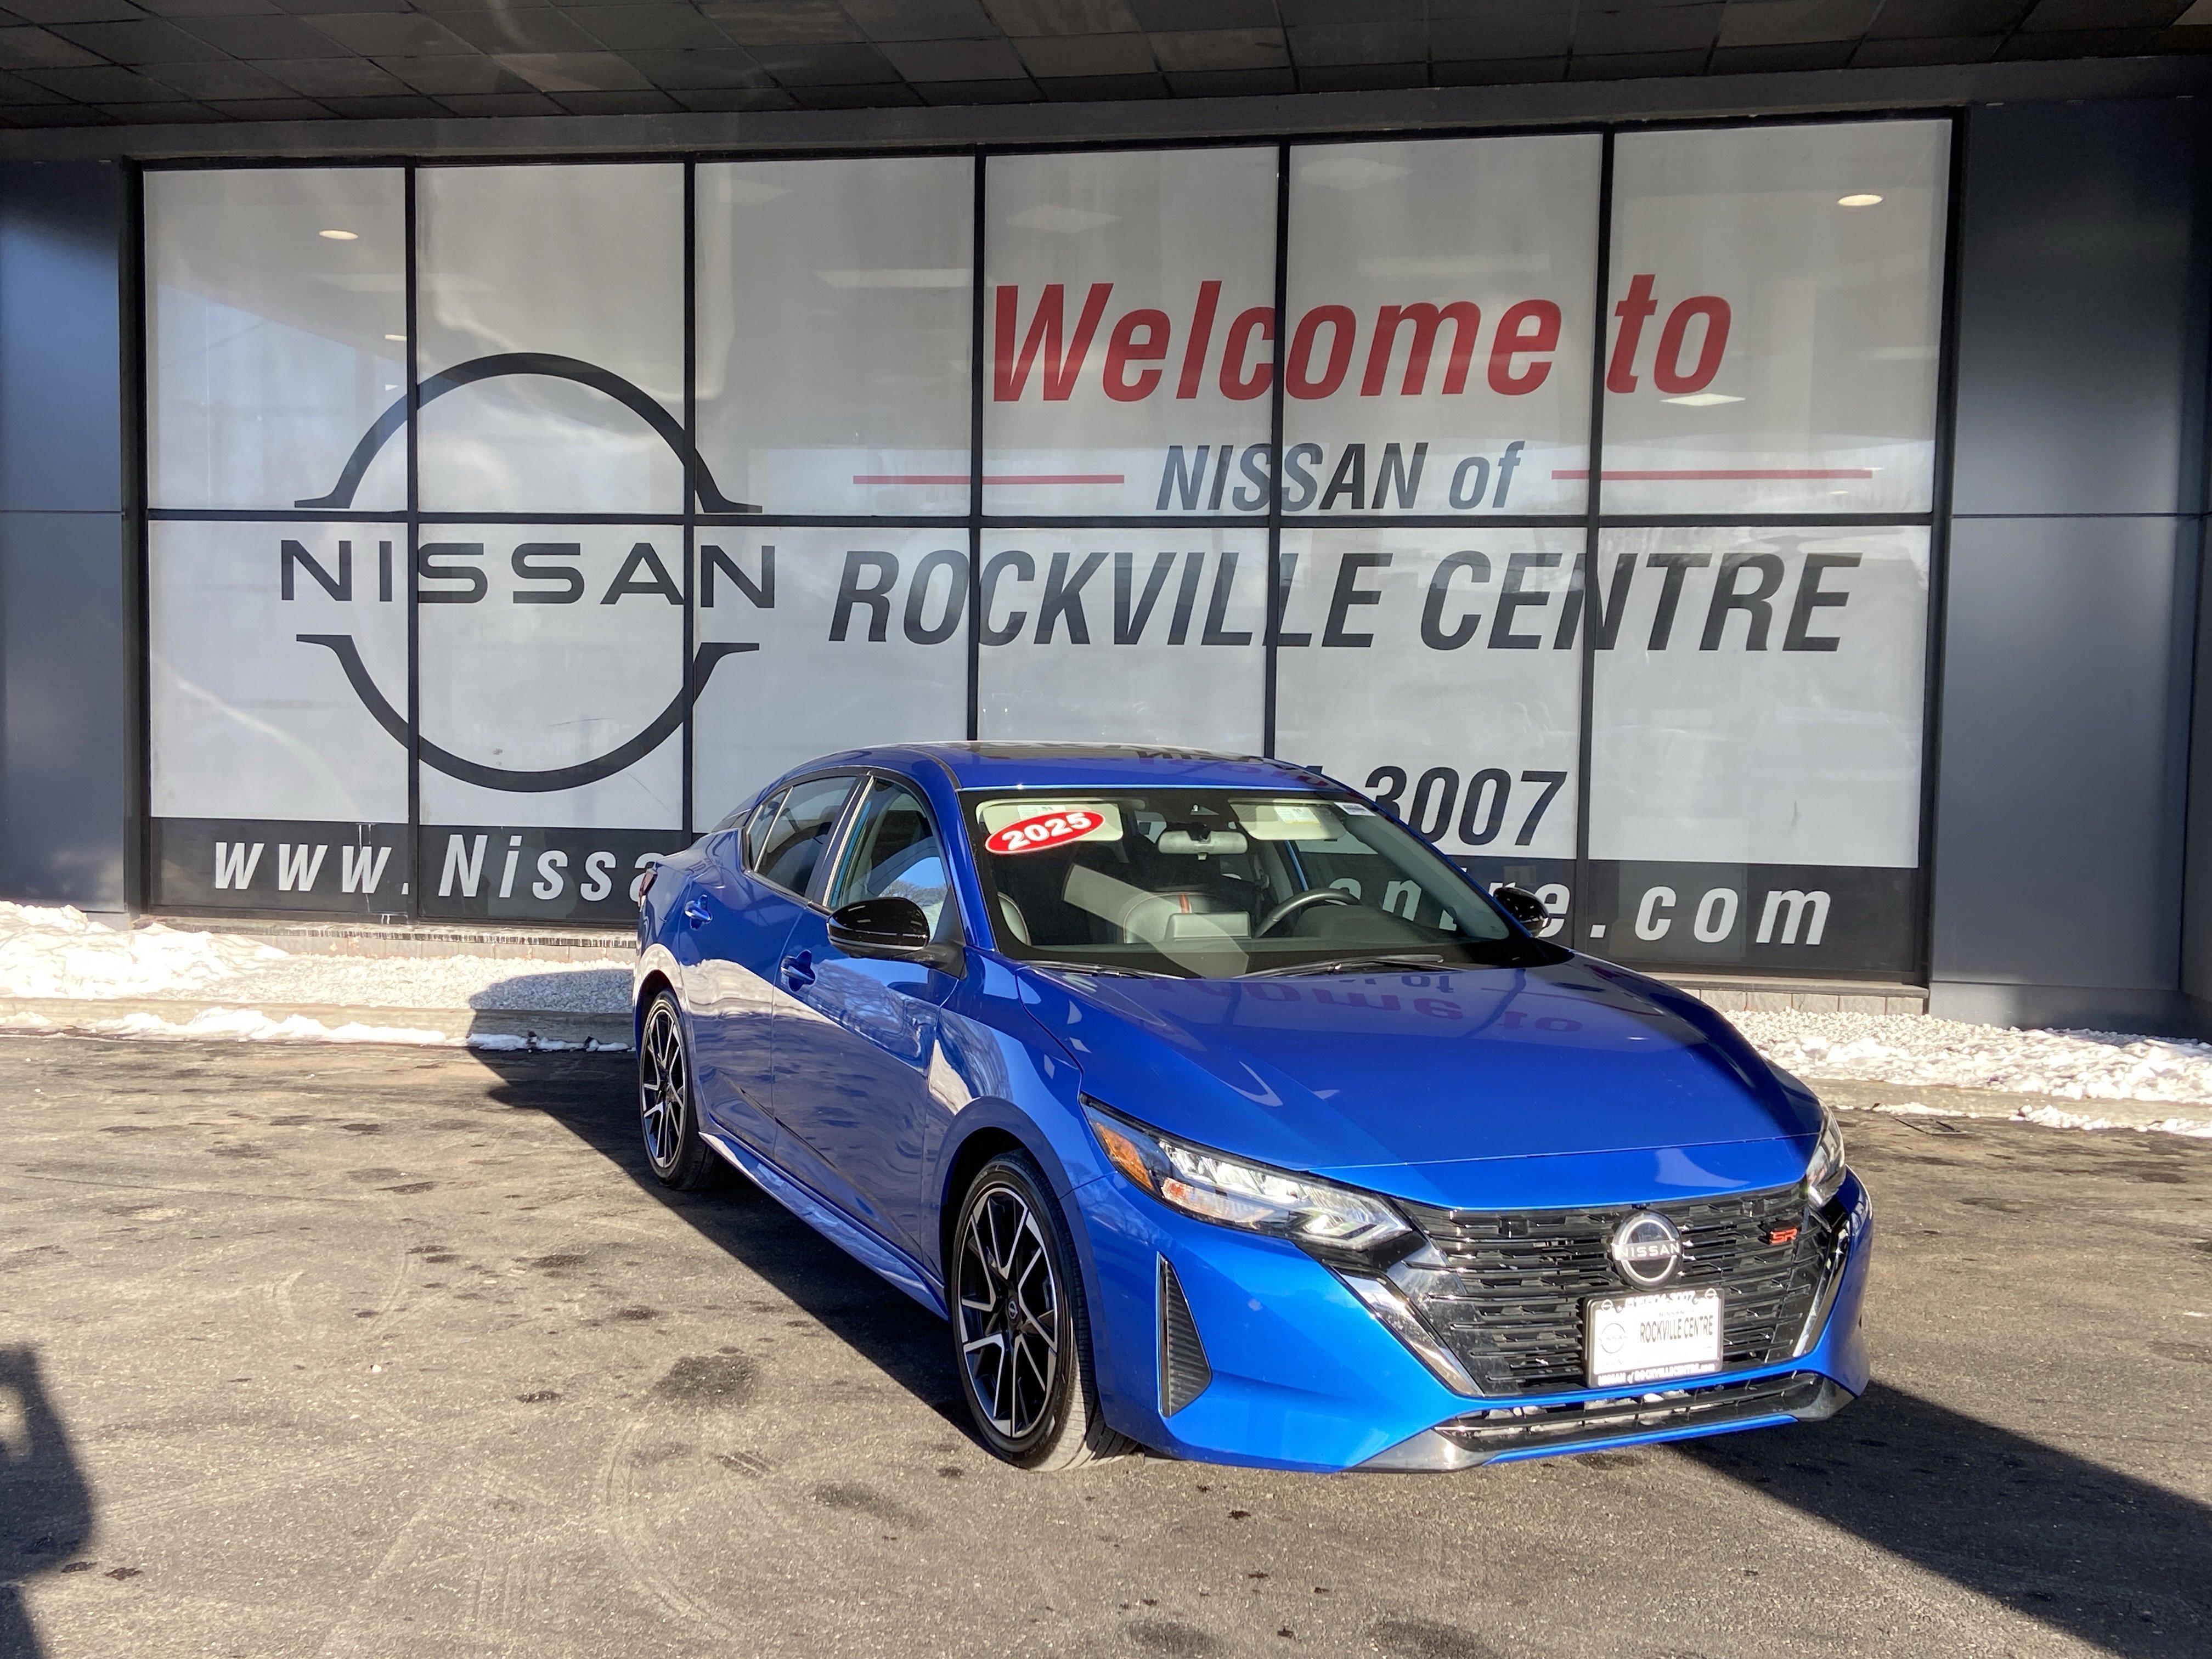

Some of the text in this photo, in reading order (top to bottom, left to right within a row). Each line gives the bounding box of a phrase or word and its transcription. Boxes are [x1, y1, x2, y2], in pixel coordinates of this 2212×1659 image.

[993, 274, 1732, 402] Welcome to
[1156, 440, 1525, 511] NISSAN of
[281, 540, 775, 608] NISSAN
[828, 550, 1863, 652] ROCKVILLE CENTRE
[1002, 812, 1092, 850] 2025
[1619, 1242, 1681, 1259] NISSAN
[1770, 1227, 1798, 1244] SR
[1640, 1315, 1714, 1344] ROCKVILLE CENTRE
